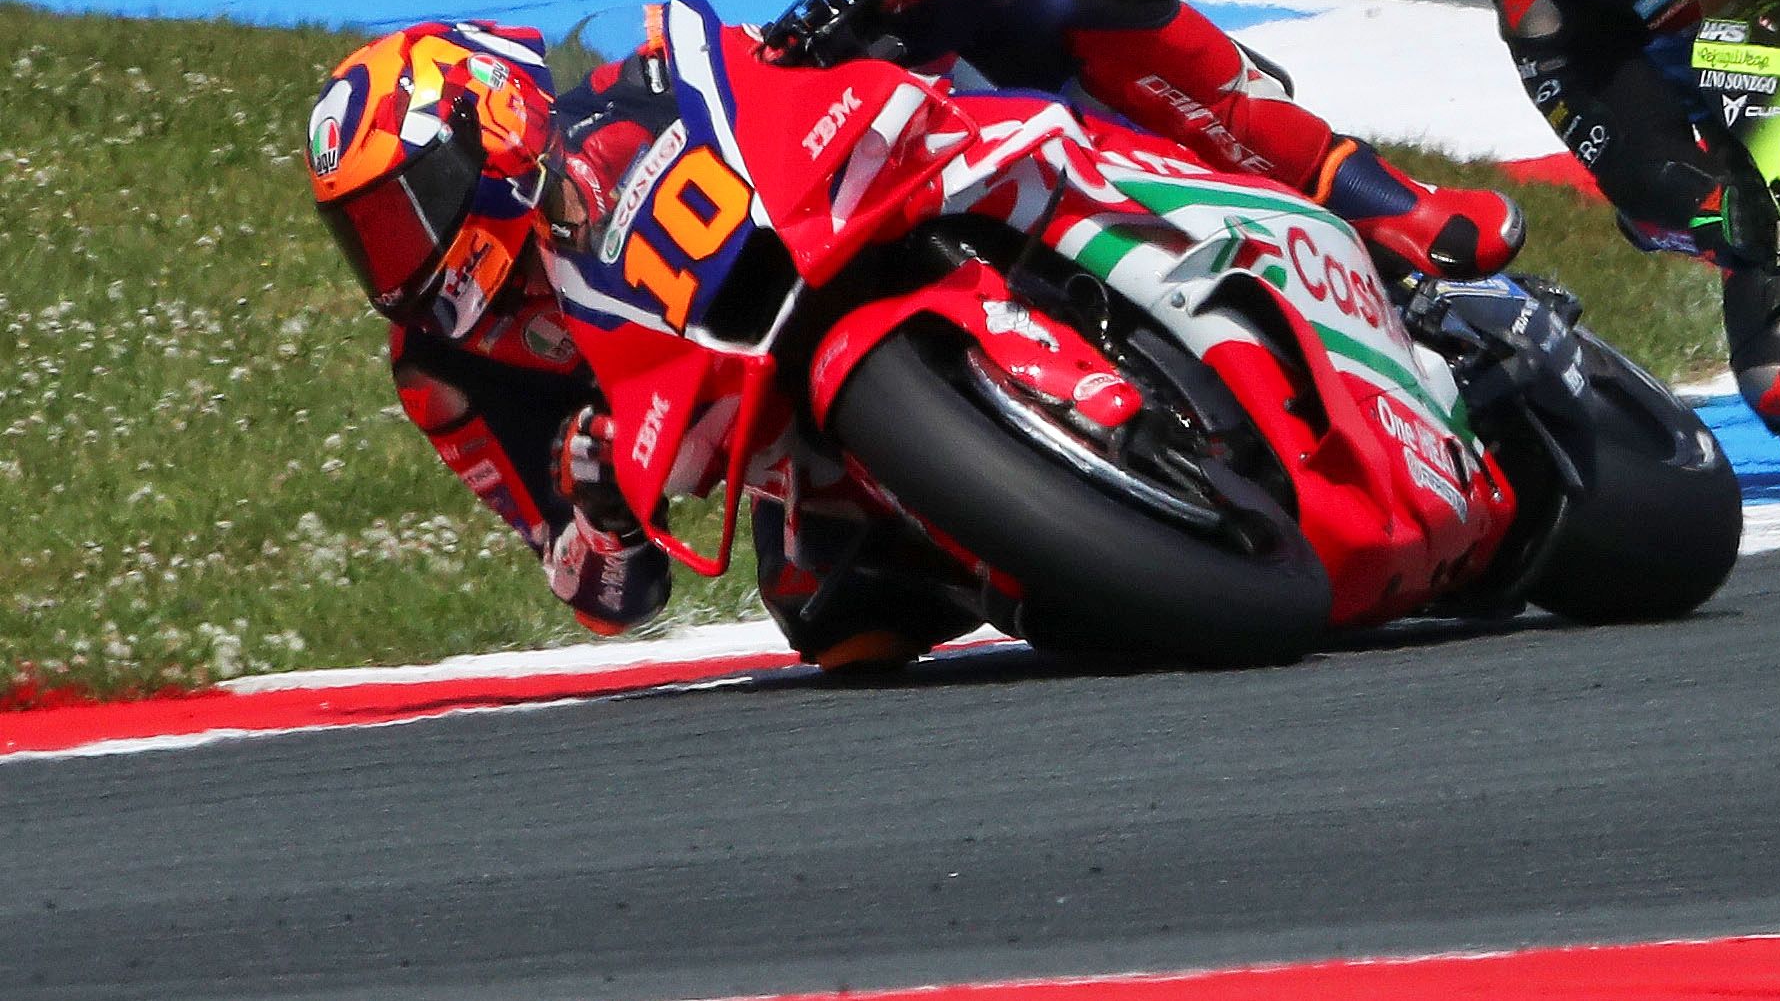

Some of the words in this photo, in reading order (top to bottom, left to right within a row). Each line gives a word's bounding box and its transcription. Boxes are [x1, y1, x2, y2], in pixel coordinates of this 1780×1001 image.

[1700, 69, 1725, 91] LINO
[1725, 73, 1778, 95] SONEGO
[802, 87, 862, 161] IBM
[624, 145, 753, 338] 10
[632, 392, 671, 469] IBM
